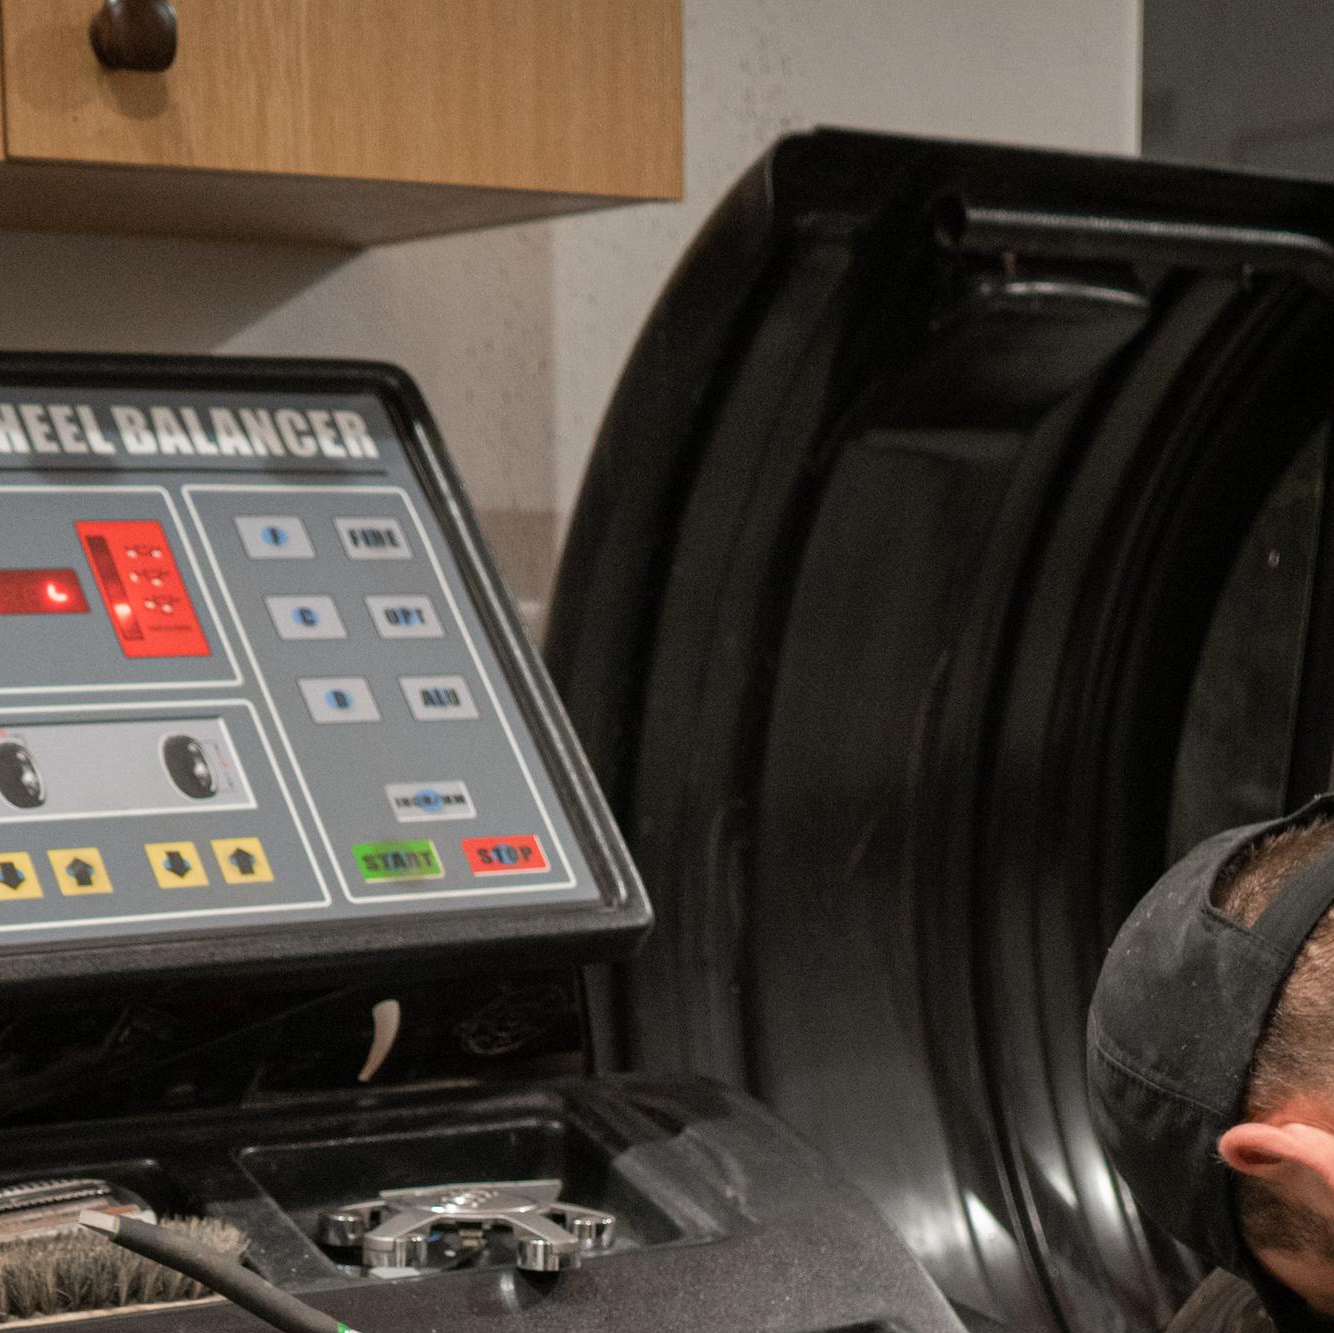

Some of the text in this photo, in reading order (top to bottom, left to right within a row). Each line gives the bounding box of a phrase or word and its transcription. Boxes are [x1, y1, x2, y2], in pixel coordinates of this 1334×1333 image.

[110, 406, 380, 458] BALANCER
[362, 850, 433, 872] START
[477, 845, 533, 865] STOP
